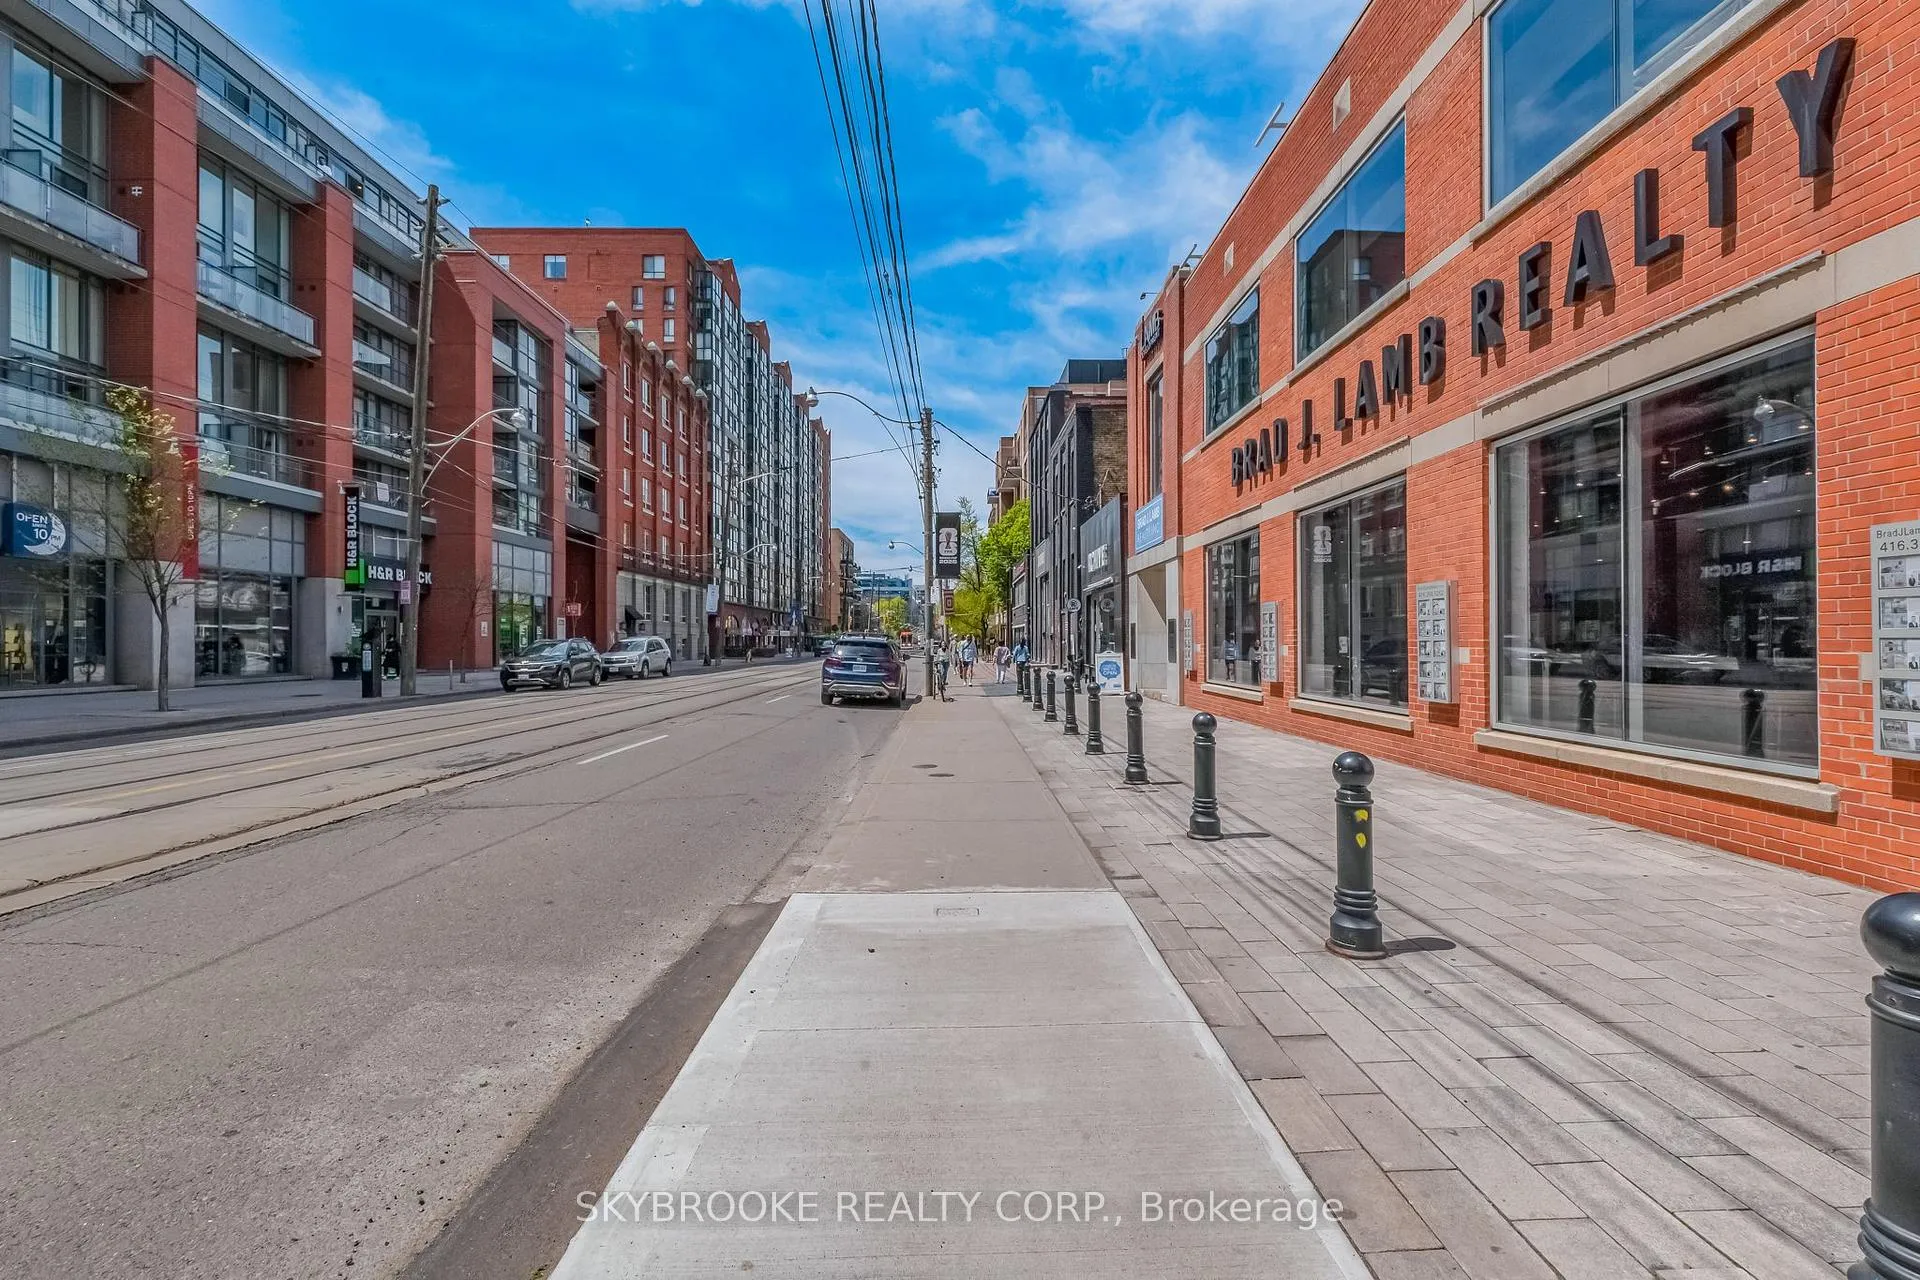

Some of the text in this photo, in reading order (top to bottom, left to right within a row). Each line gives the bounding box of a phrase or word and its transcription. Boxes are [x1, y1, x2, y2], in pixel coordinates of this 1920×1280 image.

[1231, 418, 1288, 487] BRAD
[1334, 315, 1446, 431] LAMB
[1471, 37, 1856, 357] REALTY
[16, 512, 48, 525] OPEN
[33, 528, 48, 540] 10
[347, 496, 357, 567] H&R BLOCK
[368, 565, 432, 584] H&R BCK
